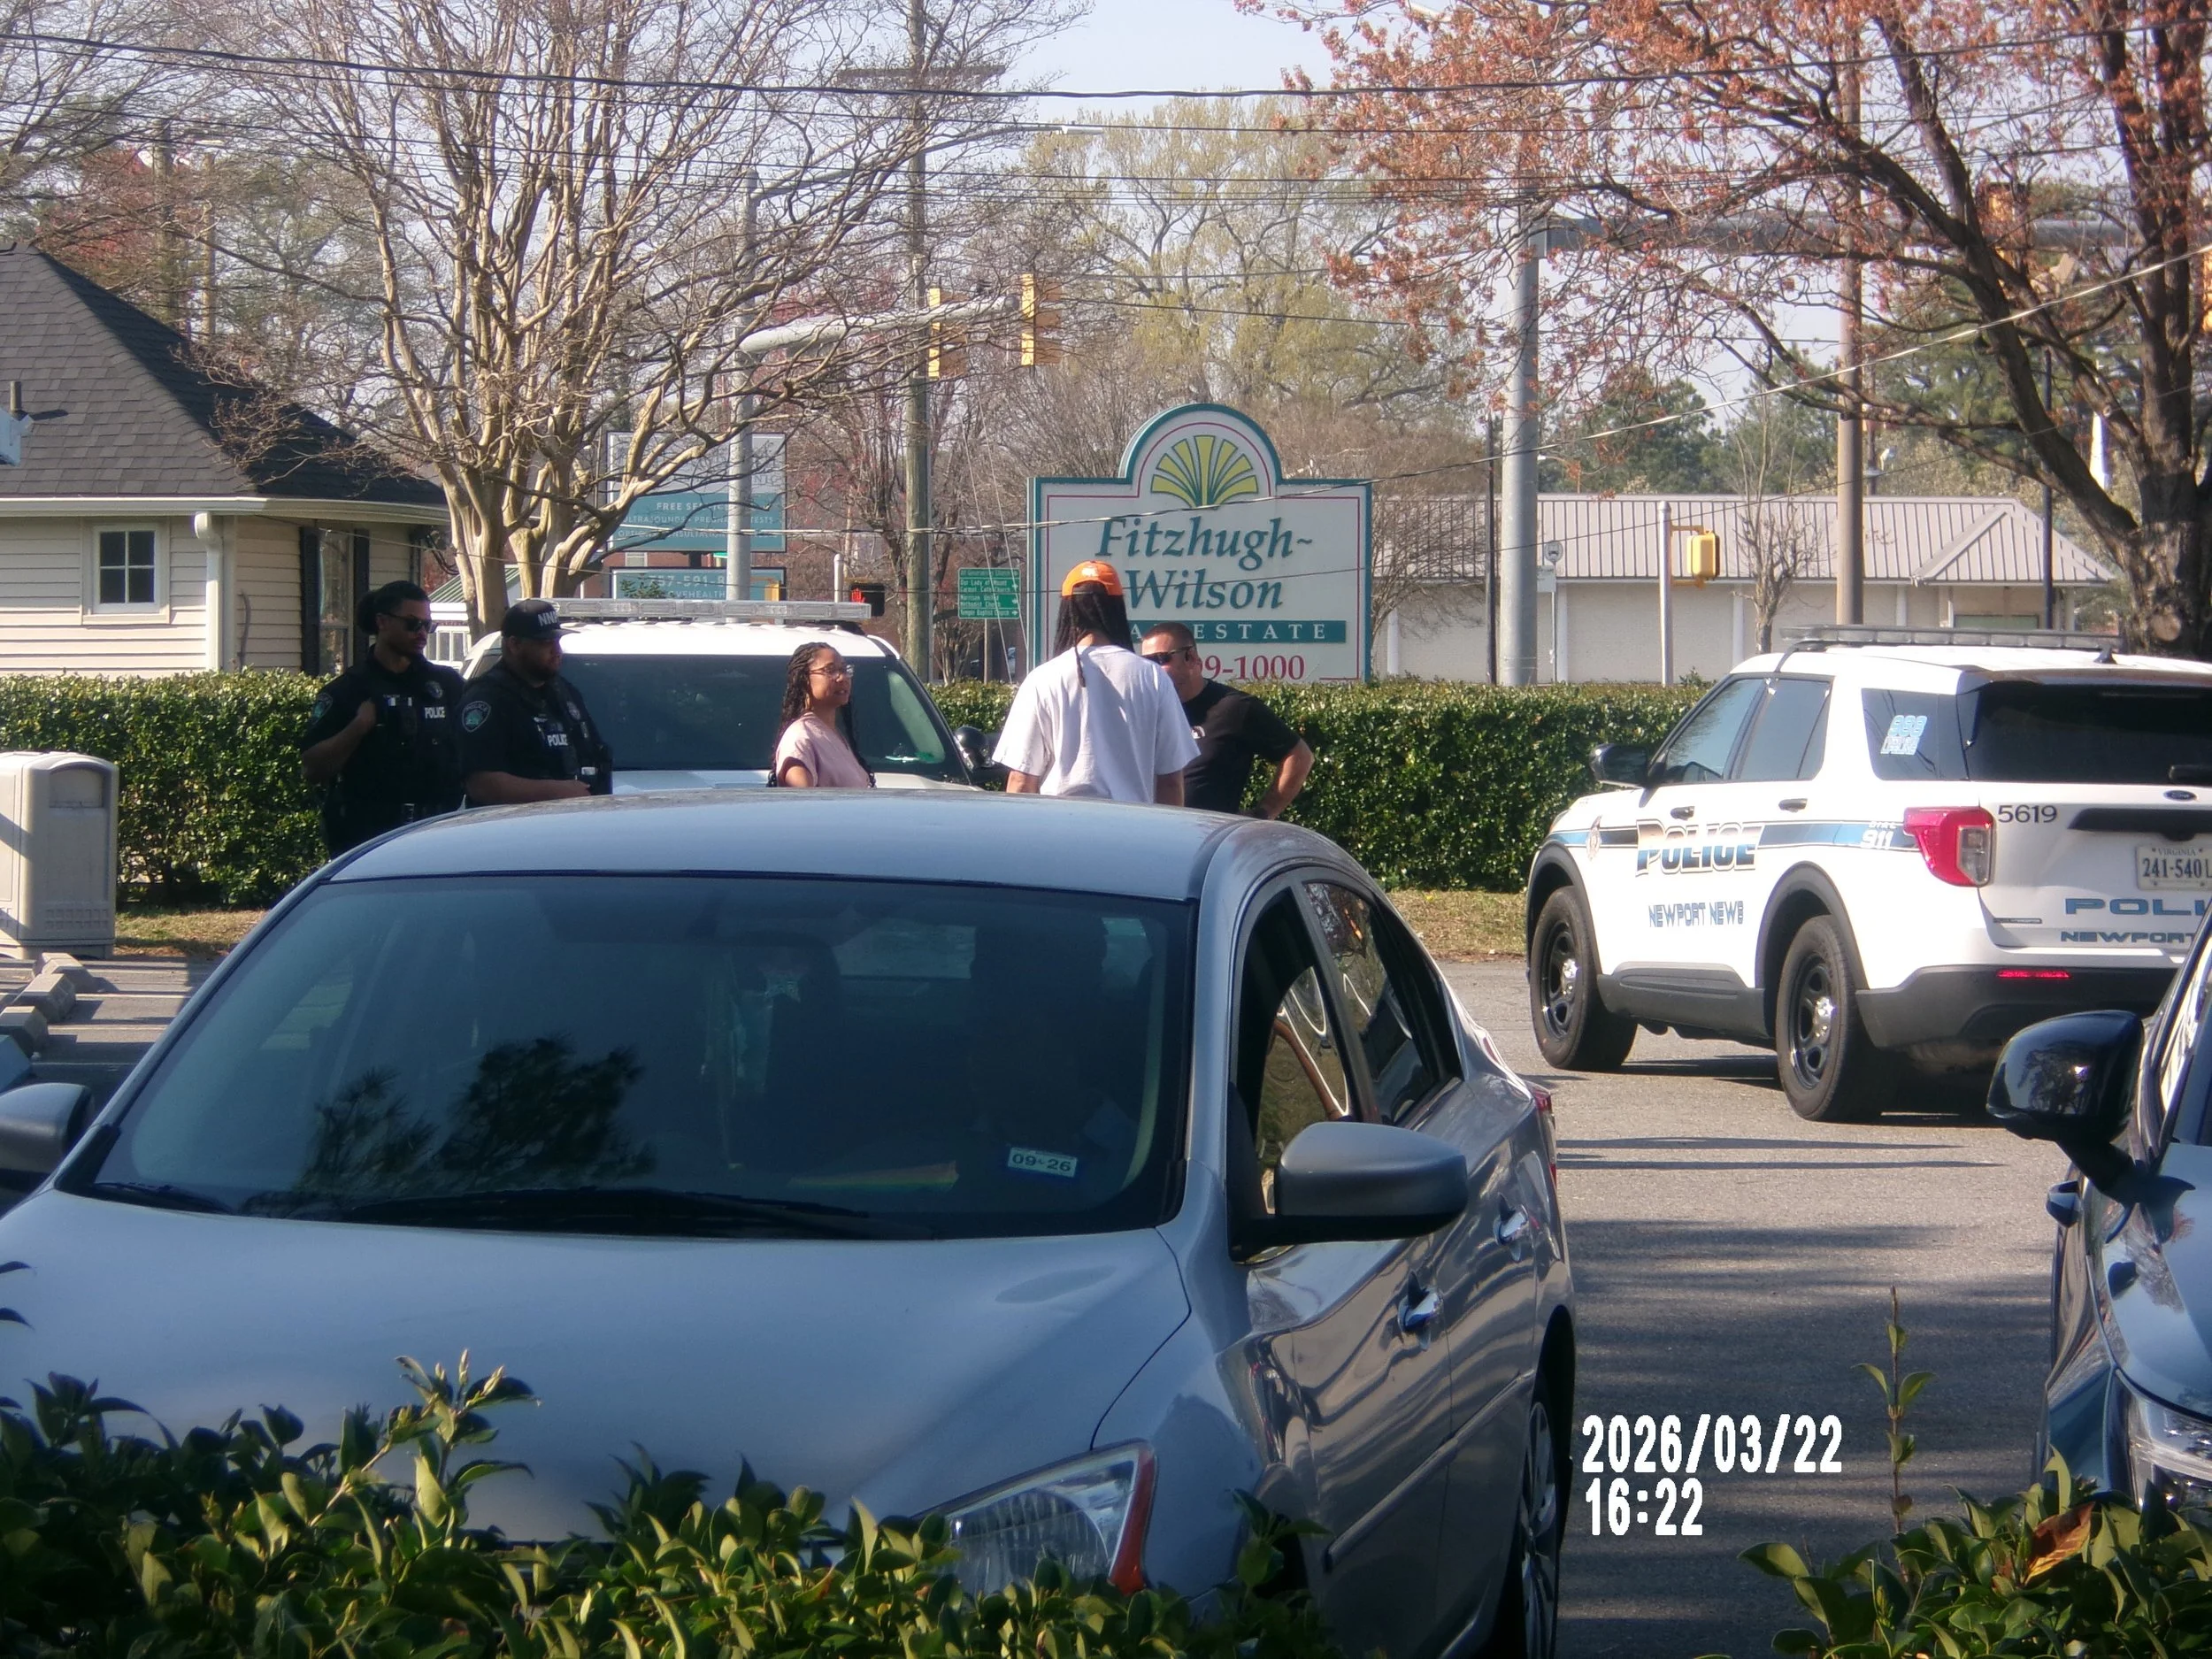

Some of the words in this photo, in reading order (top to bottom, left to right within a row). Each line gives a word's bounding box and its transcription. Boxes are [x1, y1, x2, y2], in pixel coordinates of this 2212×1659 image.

[1094, 516, 1313, 572] Fitzhugh-
[1125, 568, 1283, 609] Wilson
[1193, 623, 1325, 640] ESTATE
[425, 707, 446, 718] POLICE
[1998, 805, 2057, 823] 5619
[1636, 819, 1763, 875] POLICE
[1861, 829, 1893, 849] 911
[2158, 848, 2196, 856] VIRGINIA
[1648, 902, 1706, 927] NEWPORT
[2065, 898, 2205, 916] POLI
[1012, 1154, 1071, 1171] 09-26
